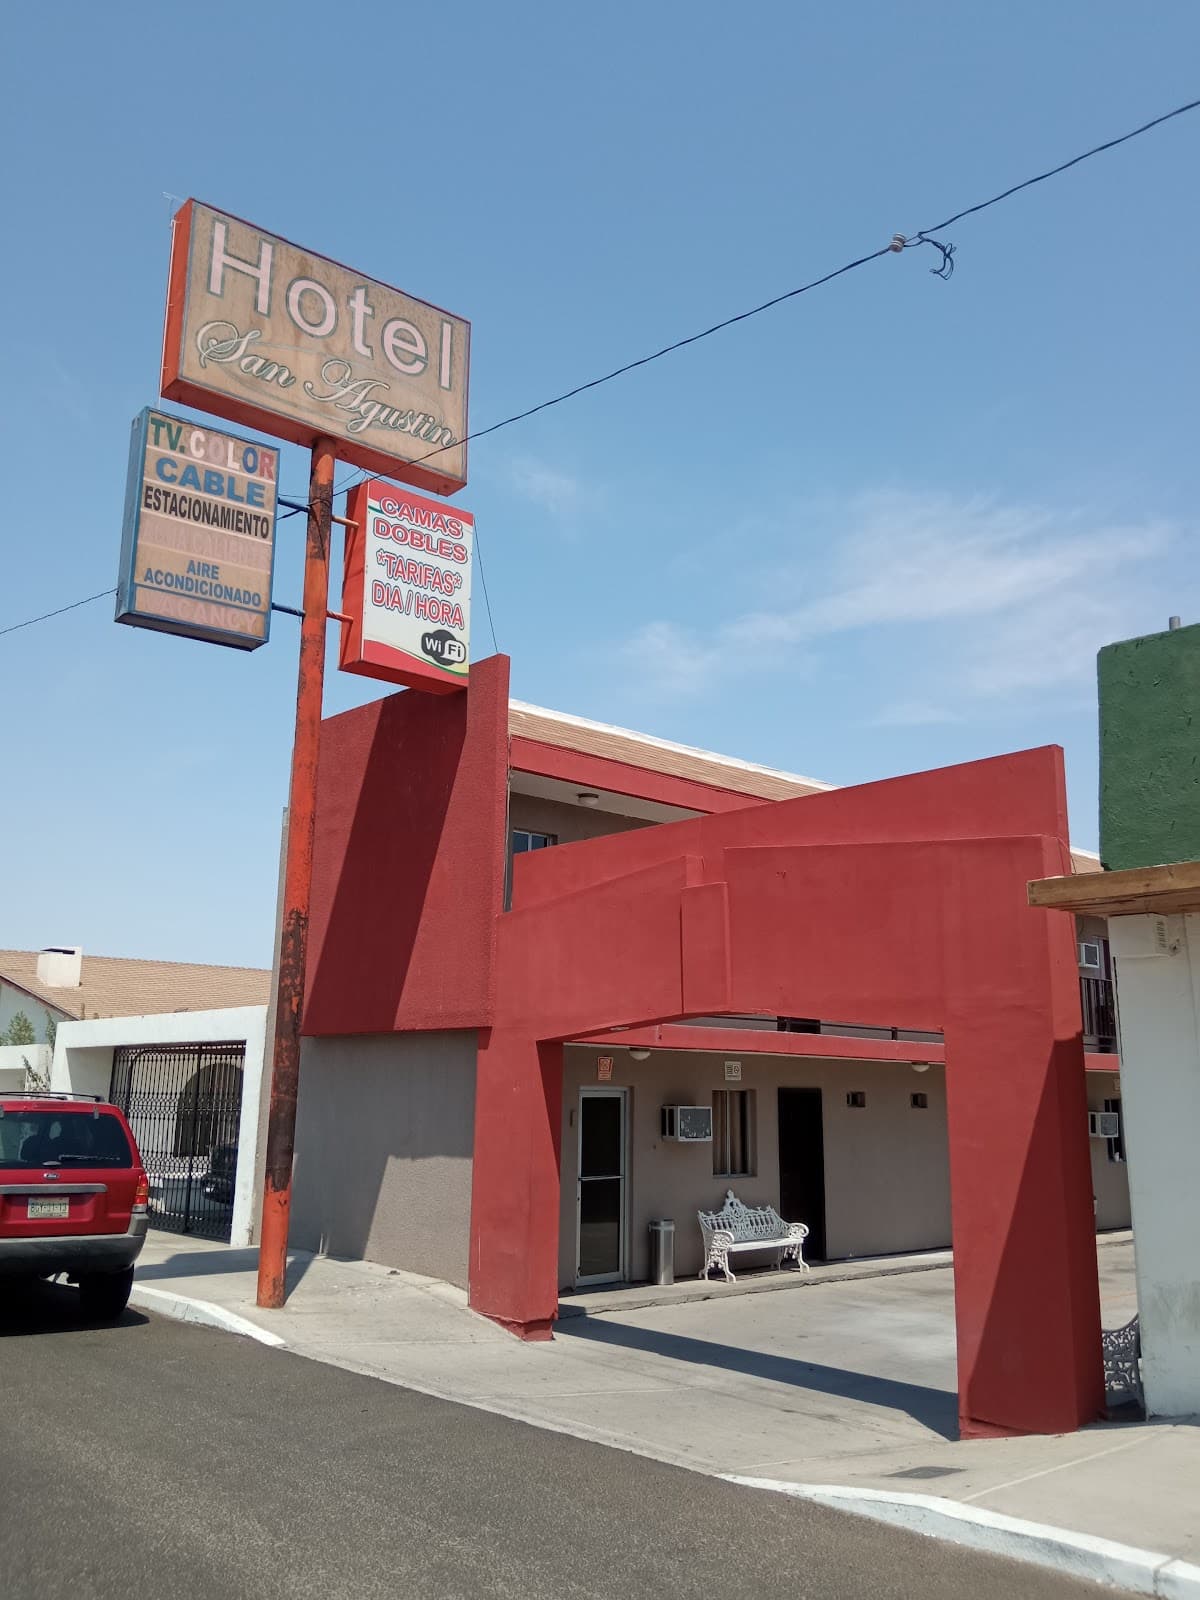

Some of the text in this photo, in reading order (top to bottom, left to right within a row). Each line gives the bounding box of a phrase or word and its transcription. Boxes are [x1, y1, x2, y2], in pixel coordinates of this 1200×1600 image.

[207, 218, 453, 391] Hotel
[195, 320, 457, 448] San Agustin
[155, 457, 265, 508] CABLE
[143, 485, 269, 539] ESTACIONAMIENTO
[380, 496, 463, 538] CAMAS
[373, 518, 468, 564] DOBLES
[143, 567, 262, 607] ACONDICIONADO
[186, 559, 220, 580] AIRE
